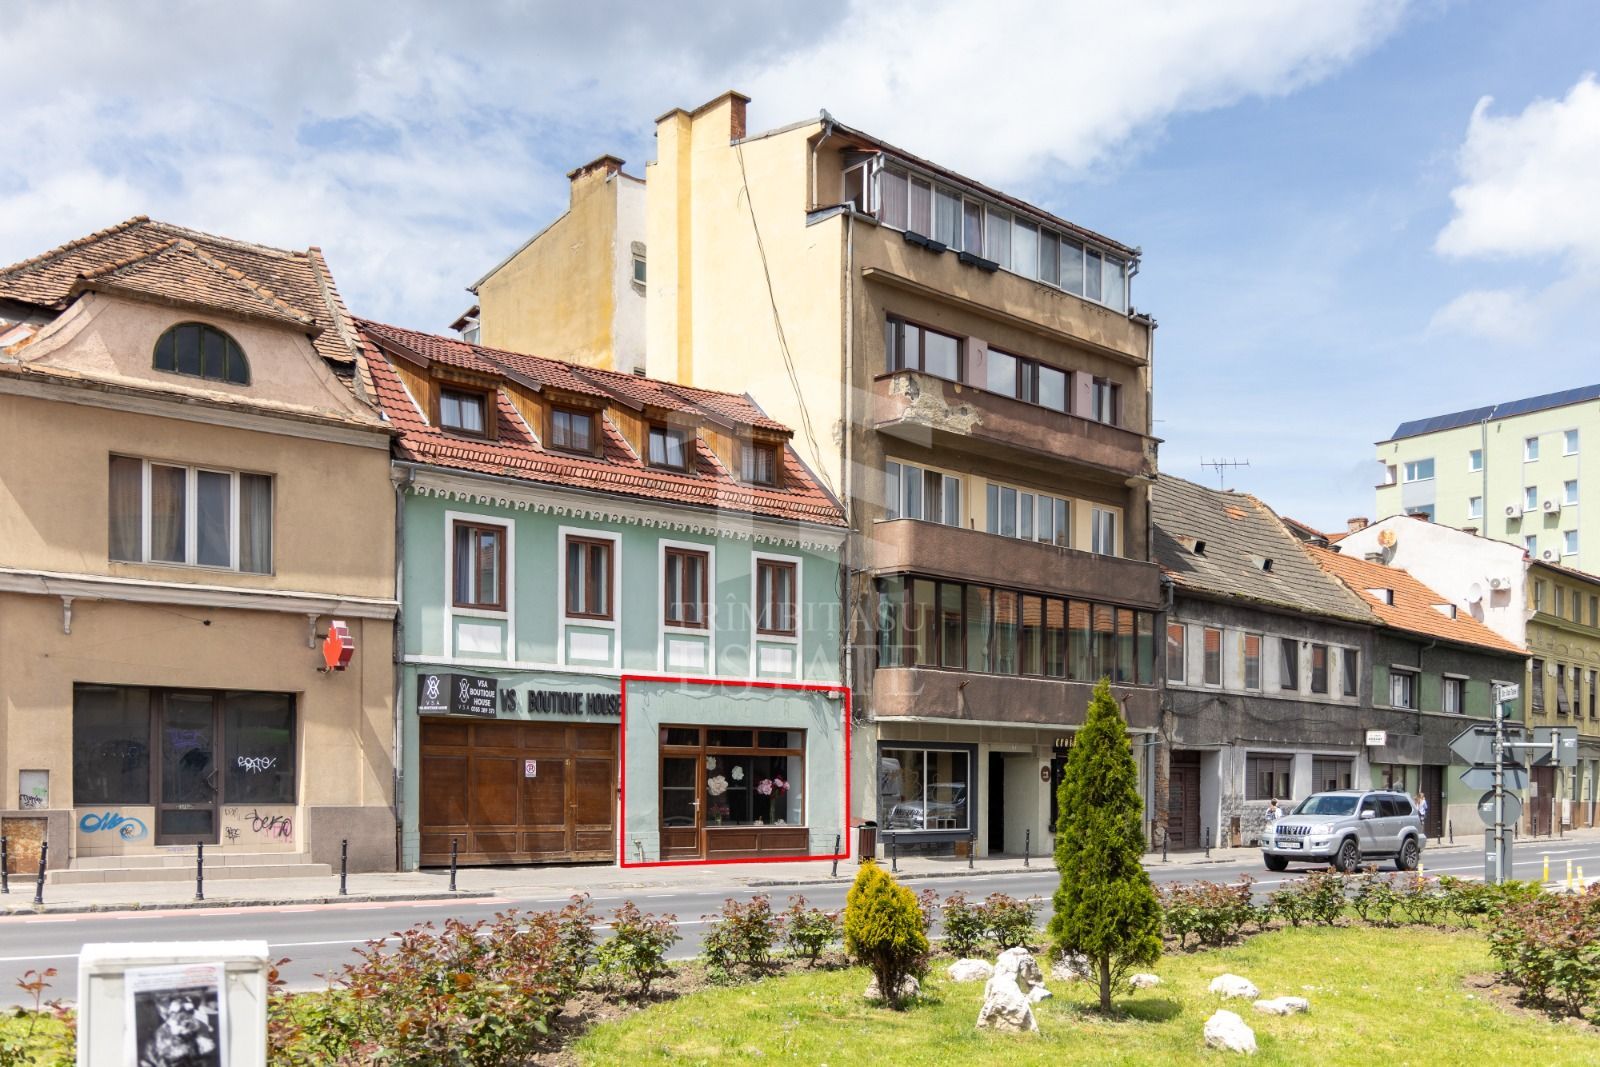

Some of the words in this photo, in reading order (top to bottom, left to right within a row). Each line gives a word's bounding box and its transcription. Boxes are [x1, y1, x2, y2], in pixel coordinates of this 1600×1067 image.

[478, 680, 488, 688] VSA
[469, 688, 495, 698] BOUTIQUE
[473, 698, 491, 707] HOUSE
[528, 690, 583, 716] BOUTIQUE
[586, 692, 622, 716] HOUSE
